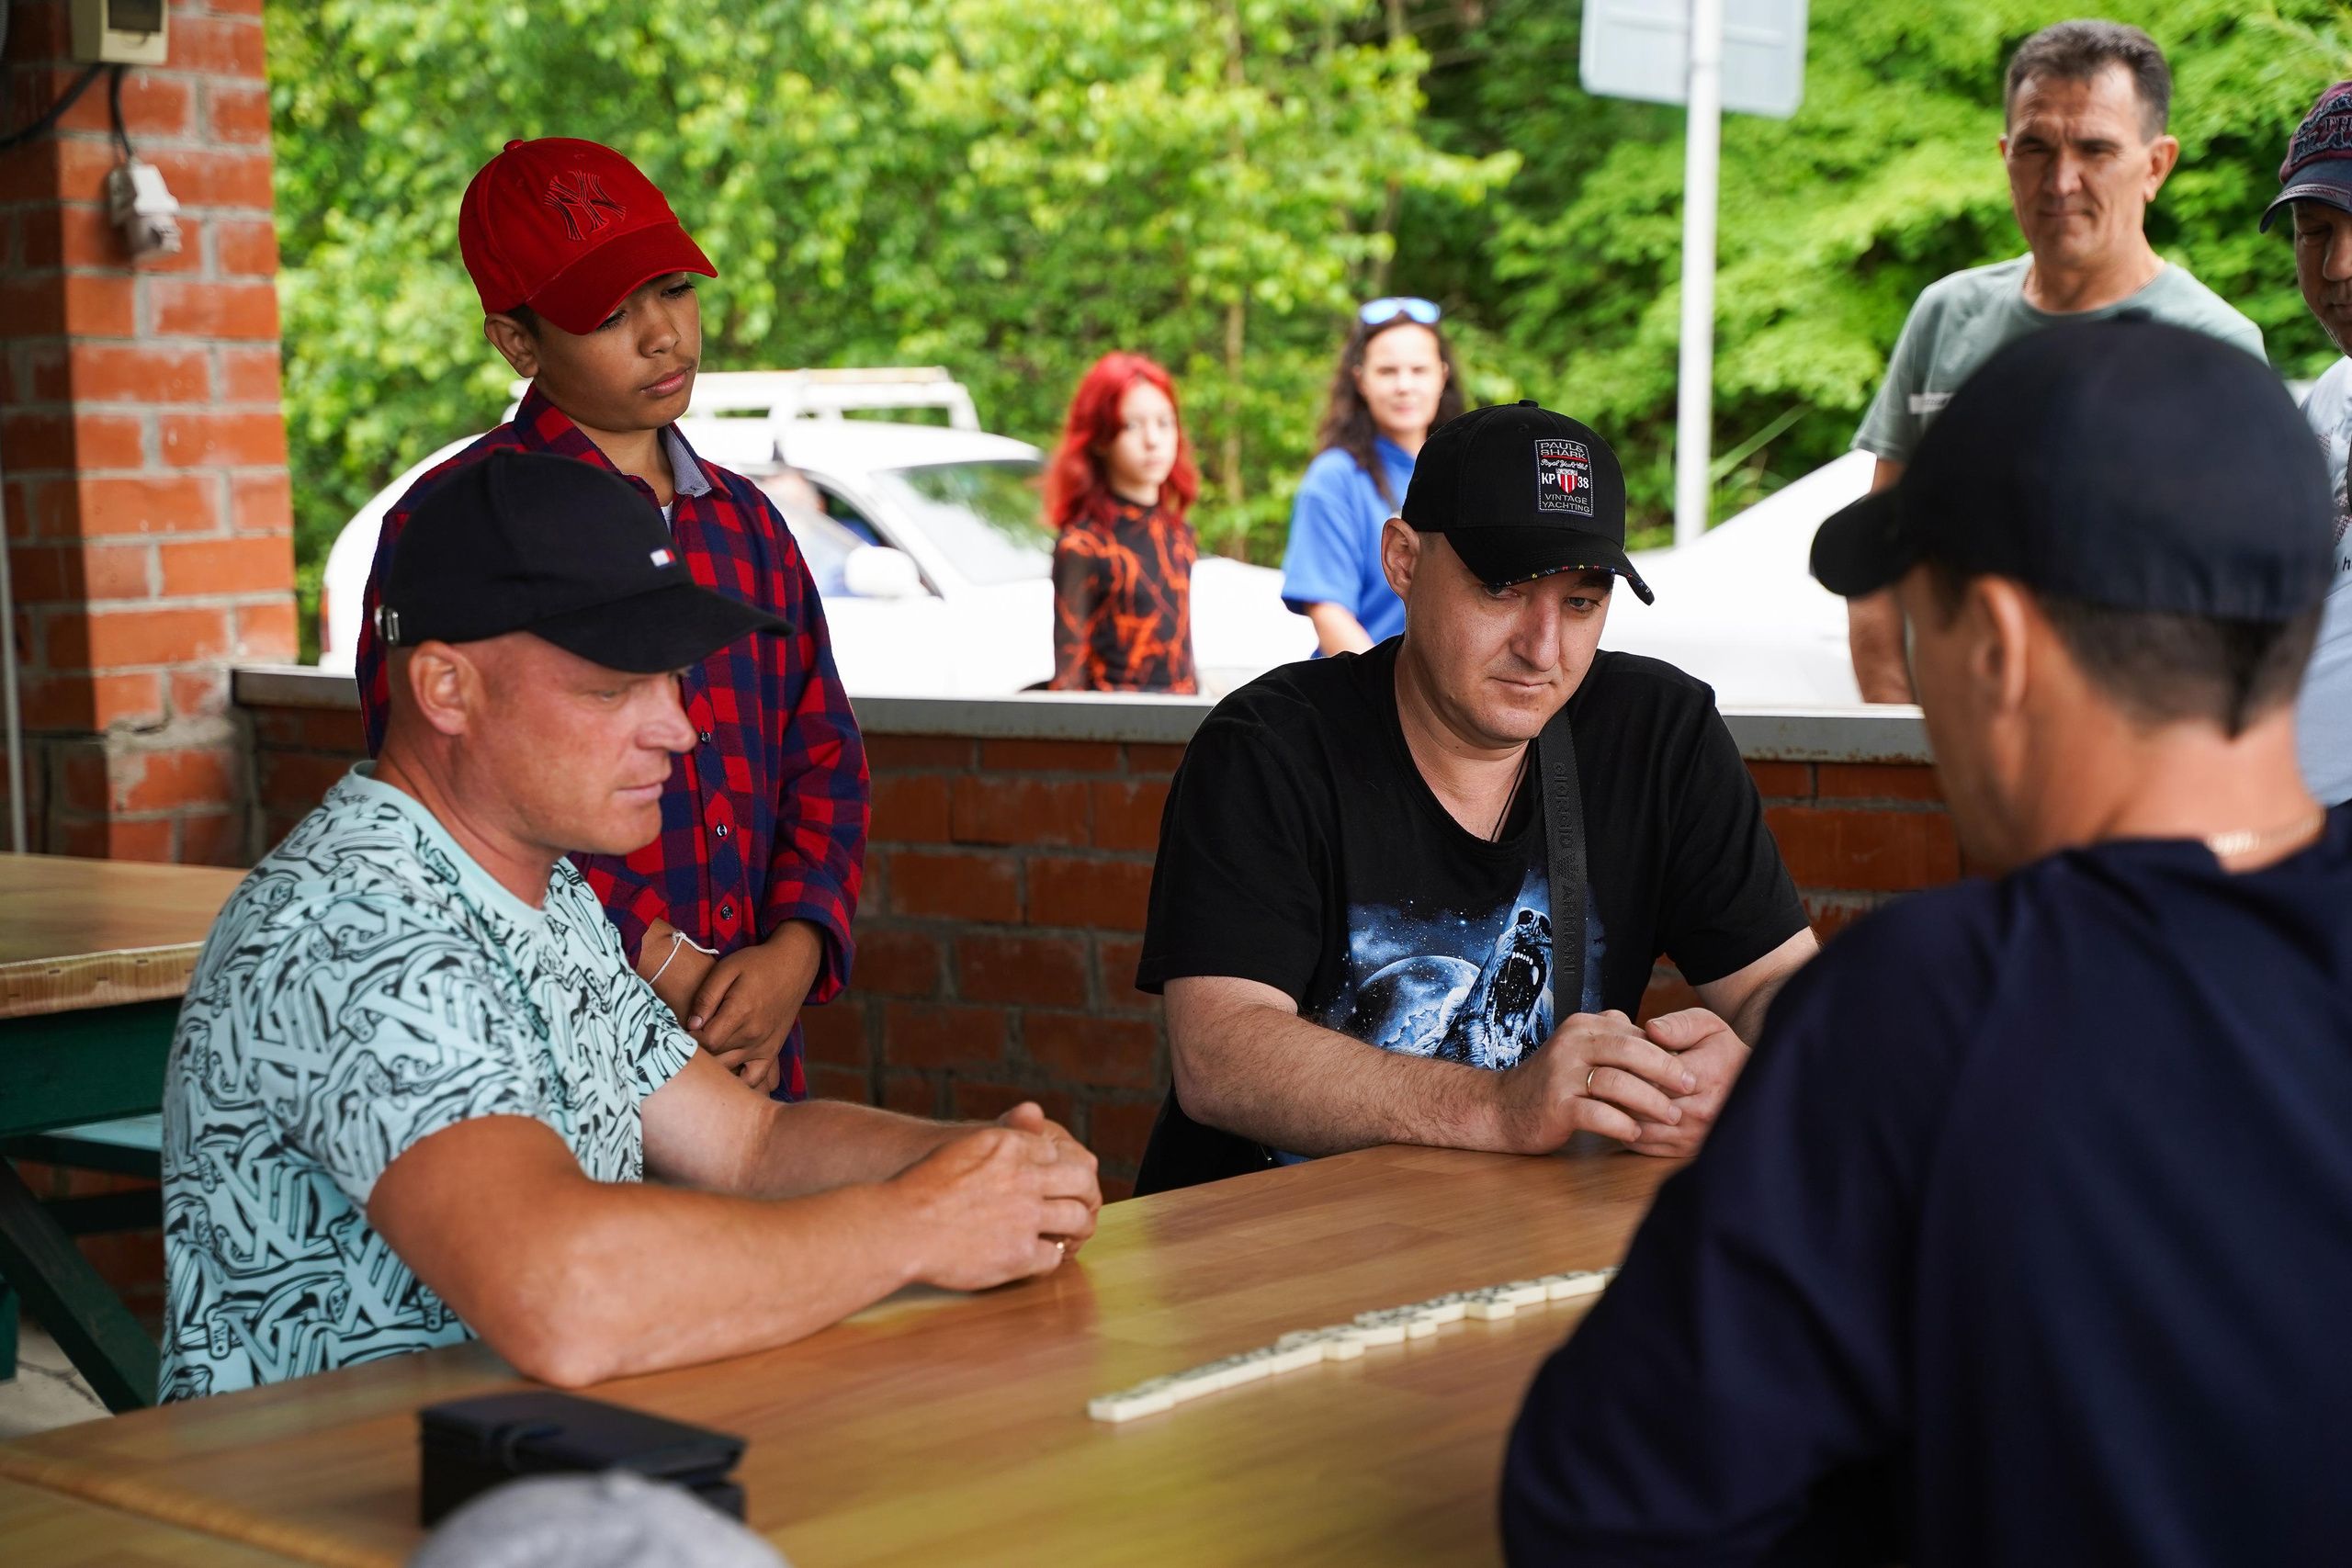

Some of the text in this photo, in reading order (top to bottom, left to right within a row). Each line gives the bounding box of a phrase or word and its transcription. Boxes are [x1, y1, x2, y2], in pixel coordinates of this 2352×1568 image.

[1540, 449, 1586, 459] SHARK
[1541, 472, 1589, 489] KP 38
[1544, 493, 1588, 505] VINTAGE
[1542, 502, 1590, 513] YACHTING
[1553, 761, 1574, 849] GIORGIO
[1562, 884, 1577, 975] ARMANI
